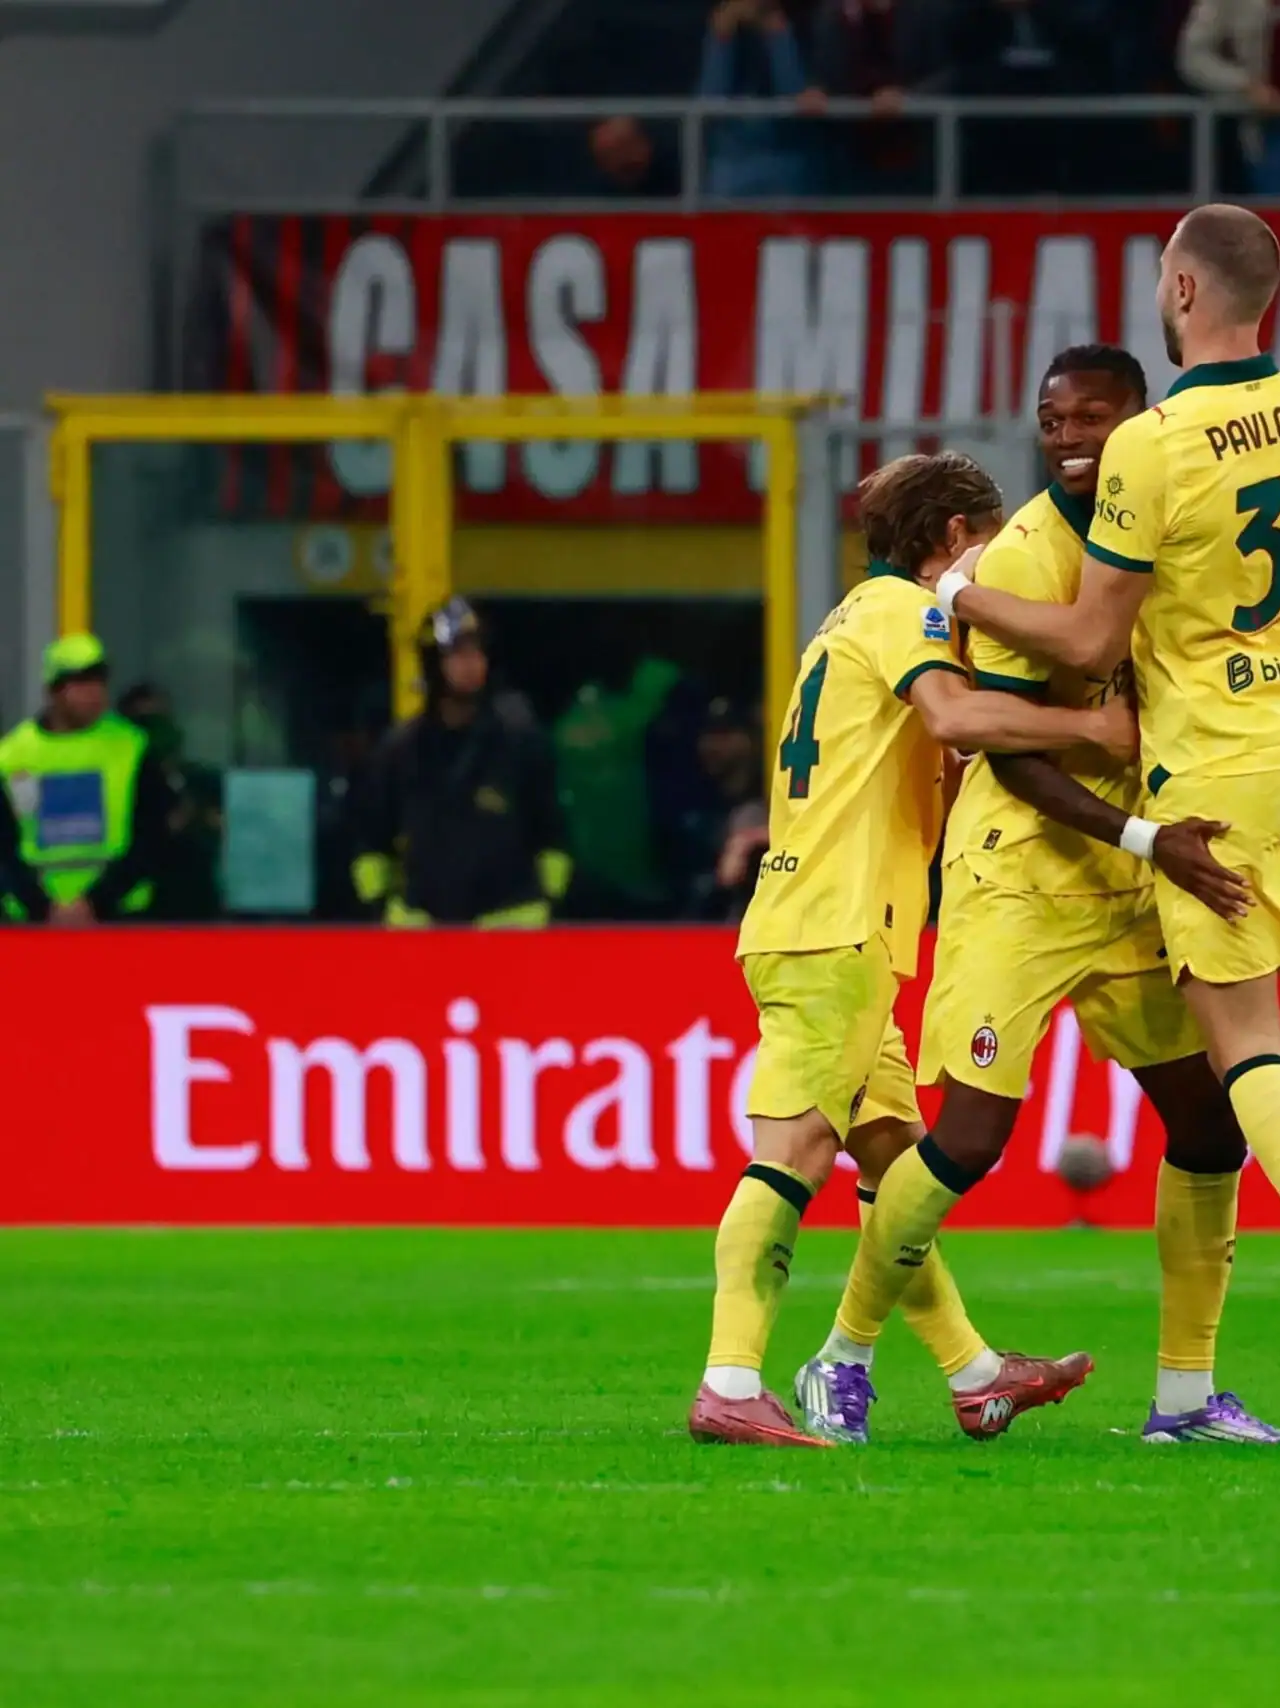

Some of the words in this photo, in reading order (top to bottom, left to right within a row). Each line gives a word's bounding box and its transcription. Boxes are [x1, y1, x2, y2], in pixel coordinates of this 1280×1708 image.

[328, 233, 700, 498] CASA
[779, 648, 828, 799] 4
[146, 998, 857, 1171] Emirat
